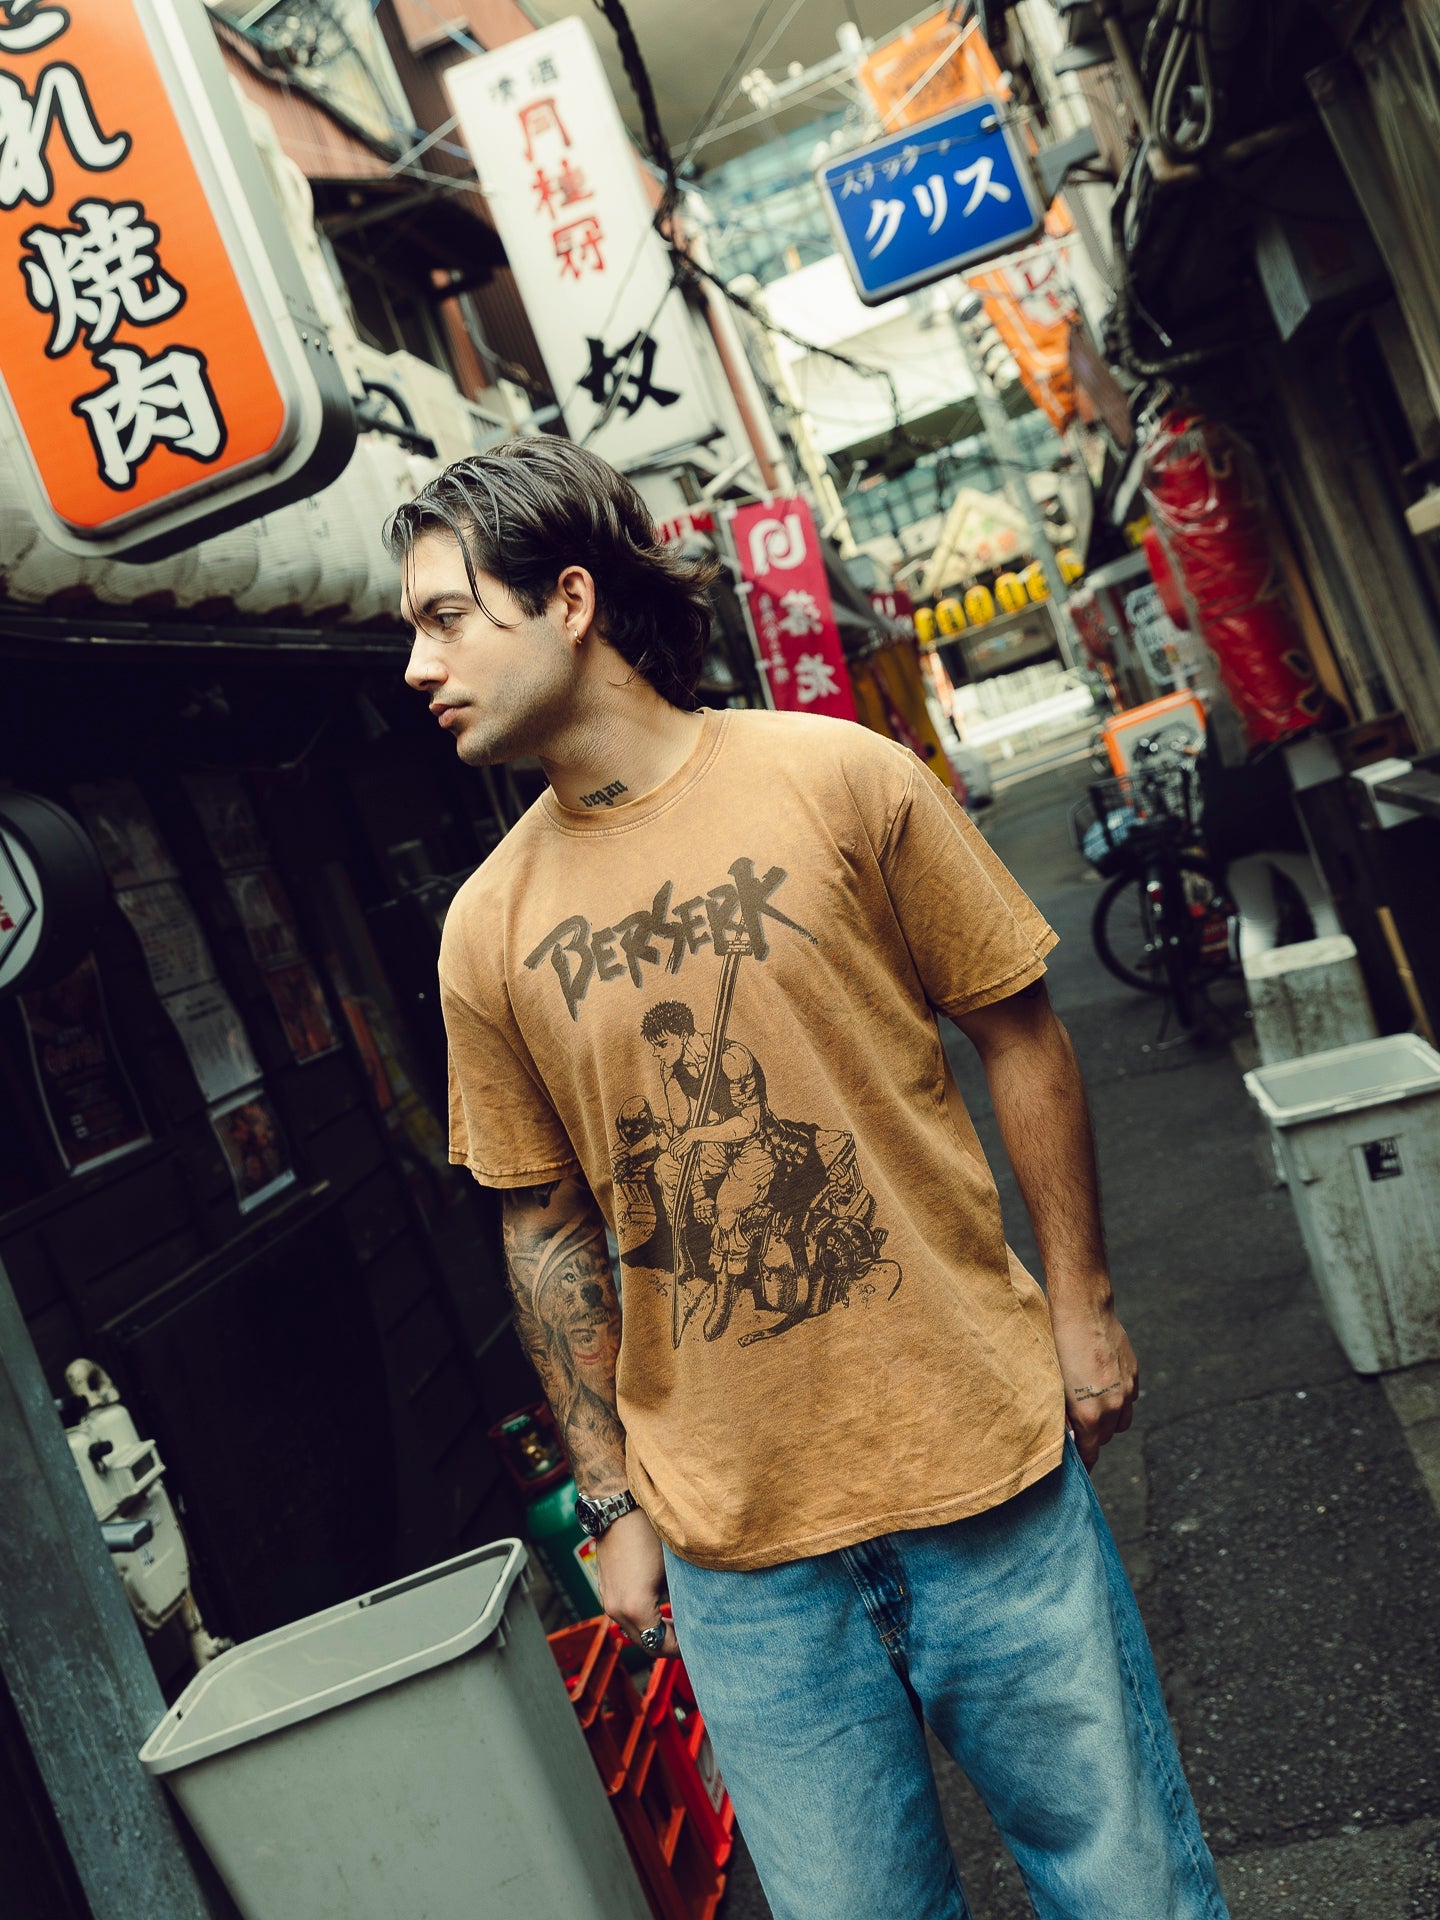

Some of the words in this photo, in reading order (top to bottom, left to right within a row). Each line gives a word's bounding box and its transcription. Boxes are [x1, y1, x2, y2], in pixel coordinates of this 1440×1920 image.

[518, 96, 606, 281] 月桂冠
[864, 155, 1012, 261] クリス
[577, 330, 681, 421] 奴
[579, 780, 628, 807] vegan
[523, 857, 818, 1023] BERSERK
